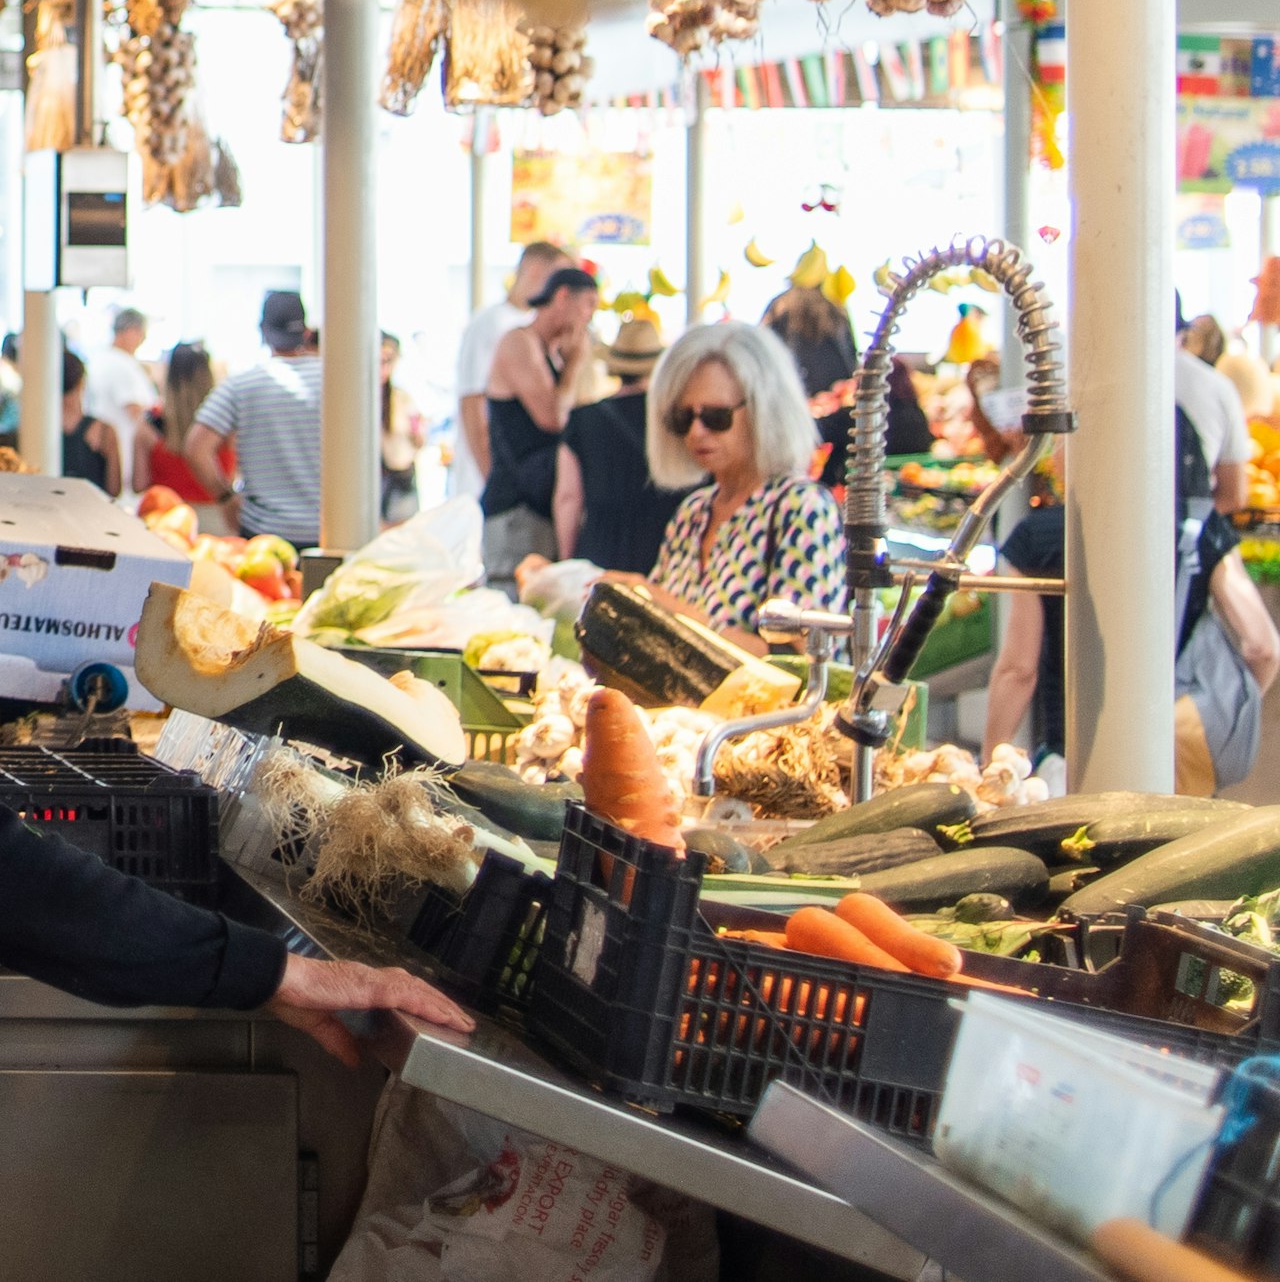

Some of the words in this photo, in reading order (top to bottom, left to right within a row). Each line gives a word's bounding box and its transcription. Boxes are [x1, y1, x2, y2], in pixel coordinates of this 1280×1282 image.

[527, 1160, 574, 1236] EXPORT
[585, 1180, 610, 1208] dry
[570, 1207, 596, 1248] place
